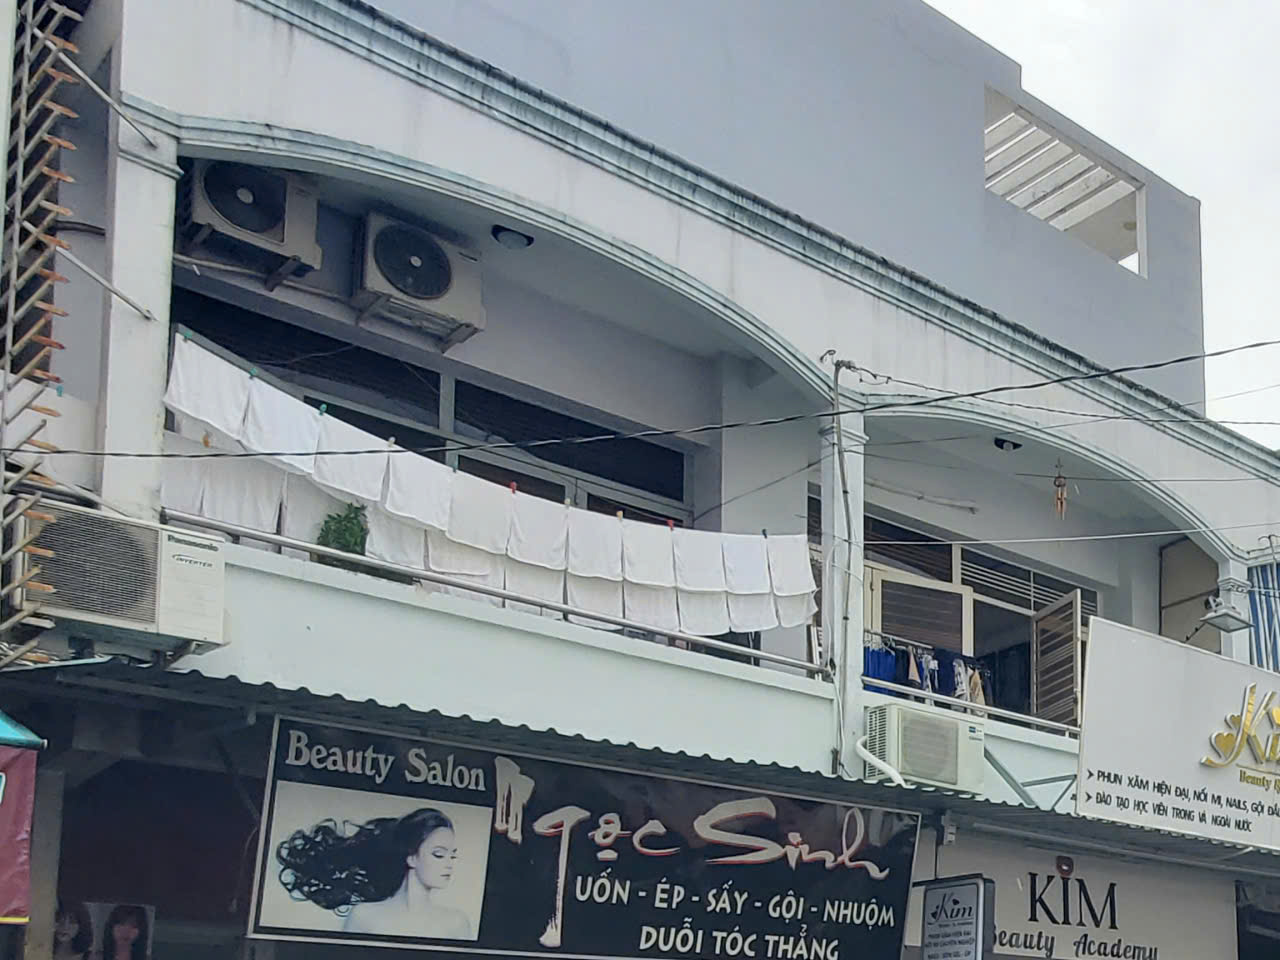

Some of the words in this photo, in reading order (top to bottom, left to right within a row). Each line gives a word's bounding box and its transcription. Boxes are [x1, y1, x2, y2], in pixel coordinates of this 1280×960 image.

[285, 730, 395, 785] Beauty
[405, 747, 486, 791] Salon
[1097, 770, 1123, 786] PHUN
[575, 867, 631, 905] UỐN
[654, 877, 685, 909] ÉP
[706, 879, 748, 915] SẤY
[768, 890, 804, 923] GỘI
[822, 898, 895, 931] NHUỘM
[639, 917, 703, 954] DUỖI
[712, 925, 757, 957] TÓC
